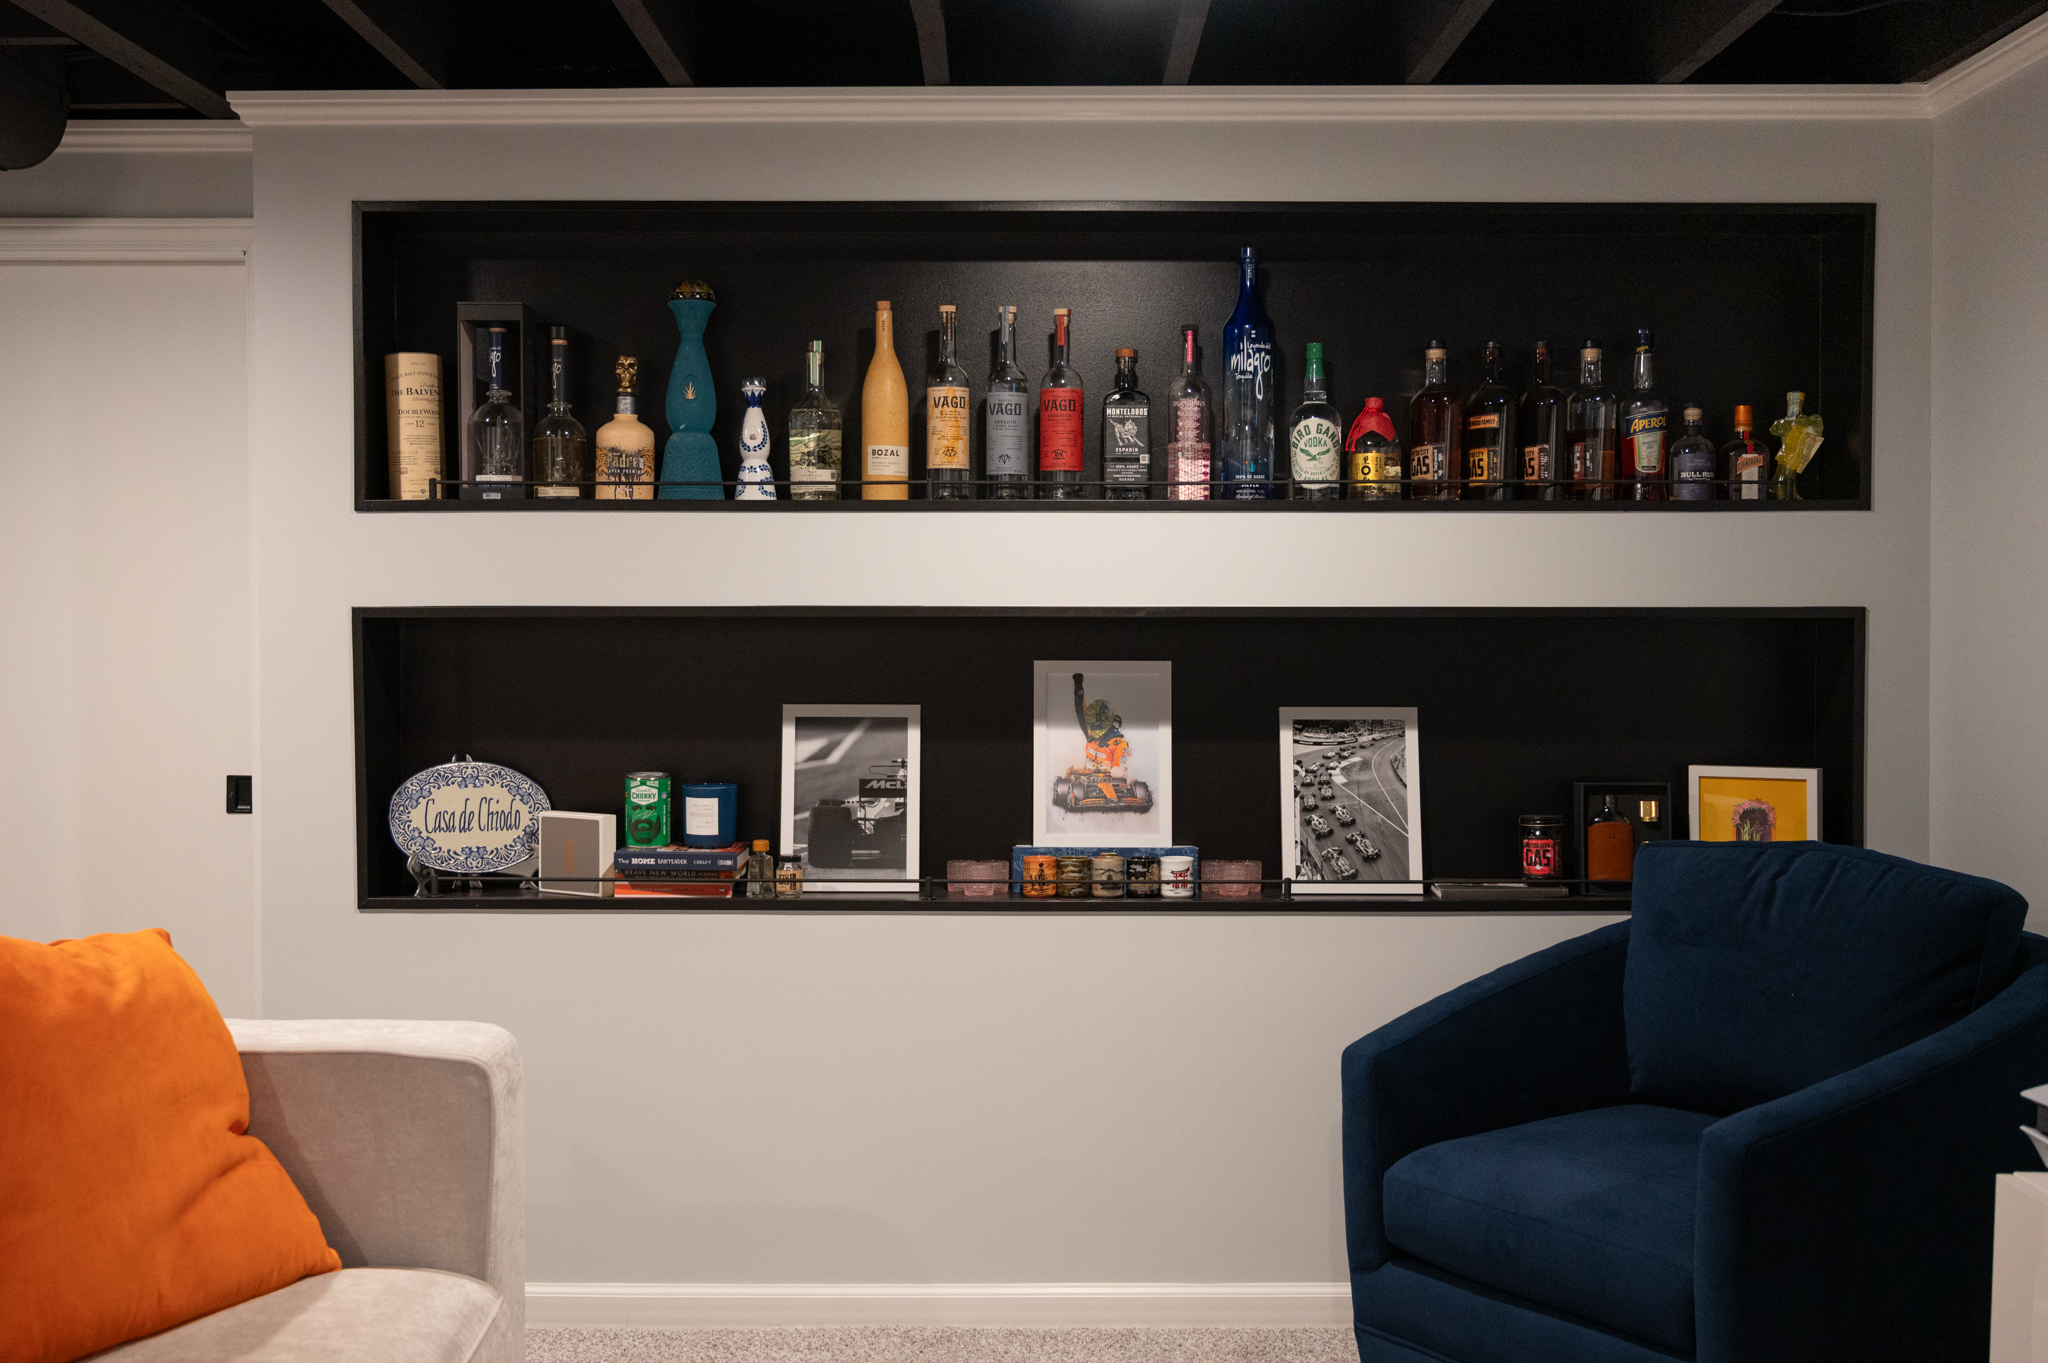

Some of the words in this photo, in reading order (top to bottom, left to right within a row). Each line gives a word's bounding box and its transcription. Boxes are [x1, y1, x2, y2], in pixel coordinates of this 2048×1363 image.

[1230, 335, 1271, 402] milagro
[1234, 372, 1252, 382] Tequila
[933, 396, 966, 409] VAGO
[989, 403, 1022, 416] VAGO
[1044, 400, 1076, 412] VAGO
[415, 420, 425, 428] 12
[1630, 416, 1666, 433] APEROL
[1292, 424, 1311, 450] BIRD
[1316, 423, 1339, 448] GANG
[1304, 436, 1328, 447] VODKA
[1412, 456, 1430, 476] GAS
[1470, 458, 1484, 478] AS
[1738, 457, 1762, 471] COINTREAU
[865, 780, 907, 789] McL
[425, 798, 456, 834] Casa
[459, 798, 474, 833] de
[478, 797, 520, 832] Chiodo
[1526, 849, 1550, 866] GAS
